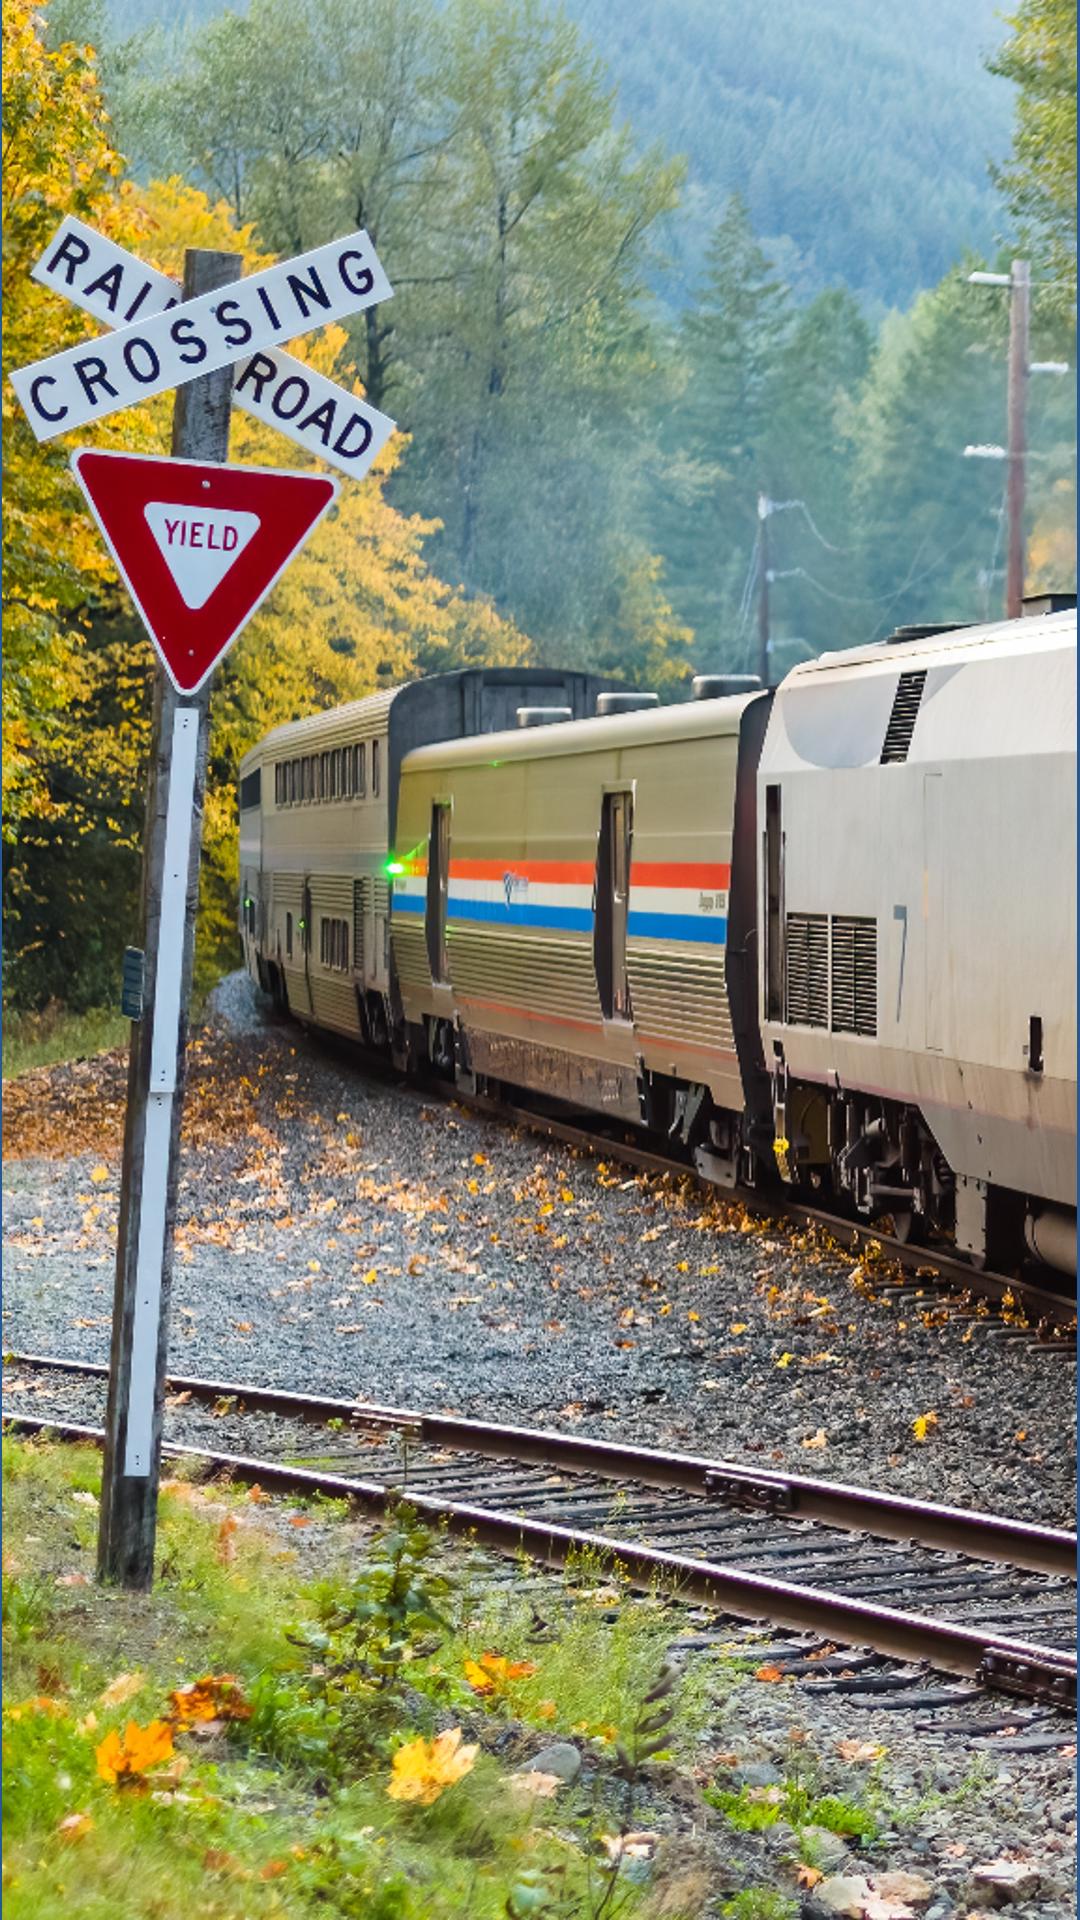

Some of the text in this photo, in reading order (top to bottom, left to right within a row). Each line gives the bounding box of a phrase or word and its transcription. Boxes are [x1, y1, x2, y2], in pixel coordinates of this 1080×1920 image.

[30, 250, 374, 422] CROSSING
[236, 353, 373, 459] ROAD
[164, 518, 239, 551] YIELD
